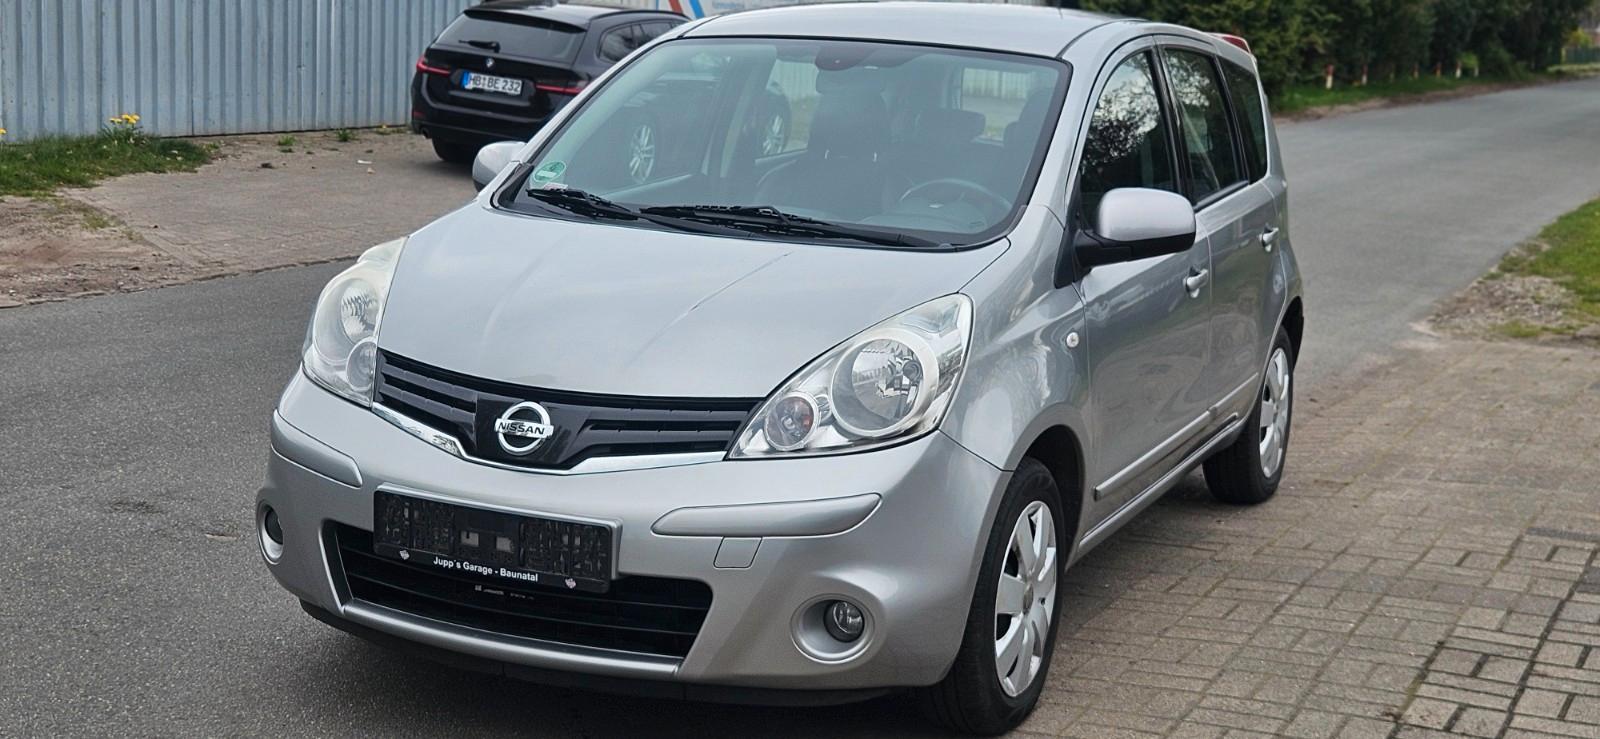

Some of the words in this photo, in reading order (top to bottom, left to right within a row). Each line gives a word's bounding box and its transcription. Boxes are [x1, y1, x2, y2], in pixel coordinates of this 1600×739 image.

[487, 77, 500, 89] BE
[501, 80, 521, 92] 232
[498, 421, 545, 435] NISSAN
[462, 561, 493, 575] Garage
[500, 568, 538, 582] Baunatal
